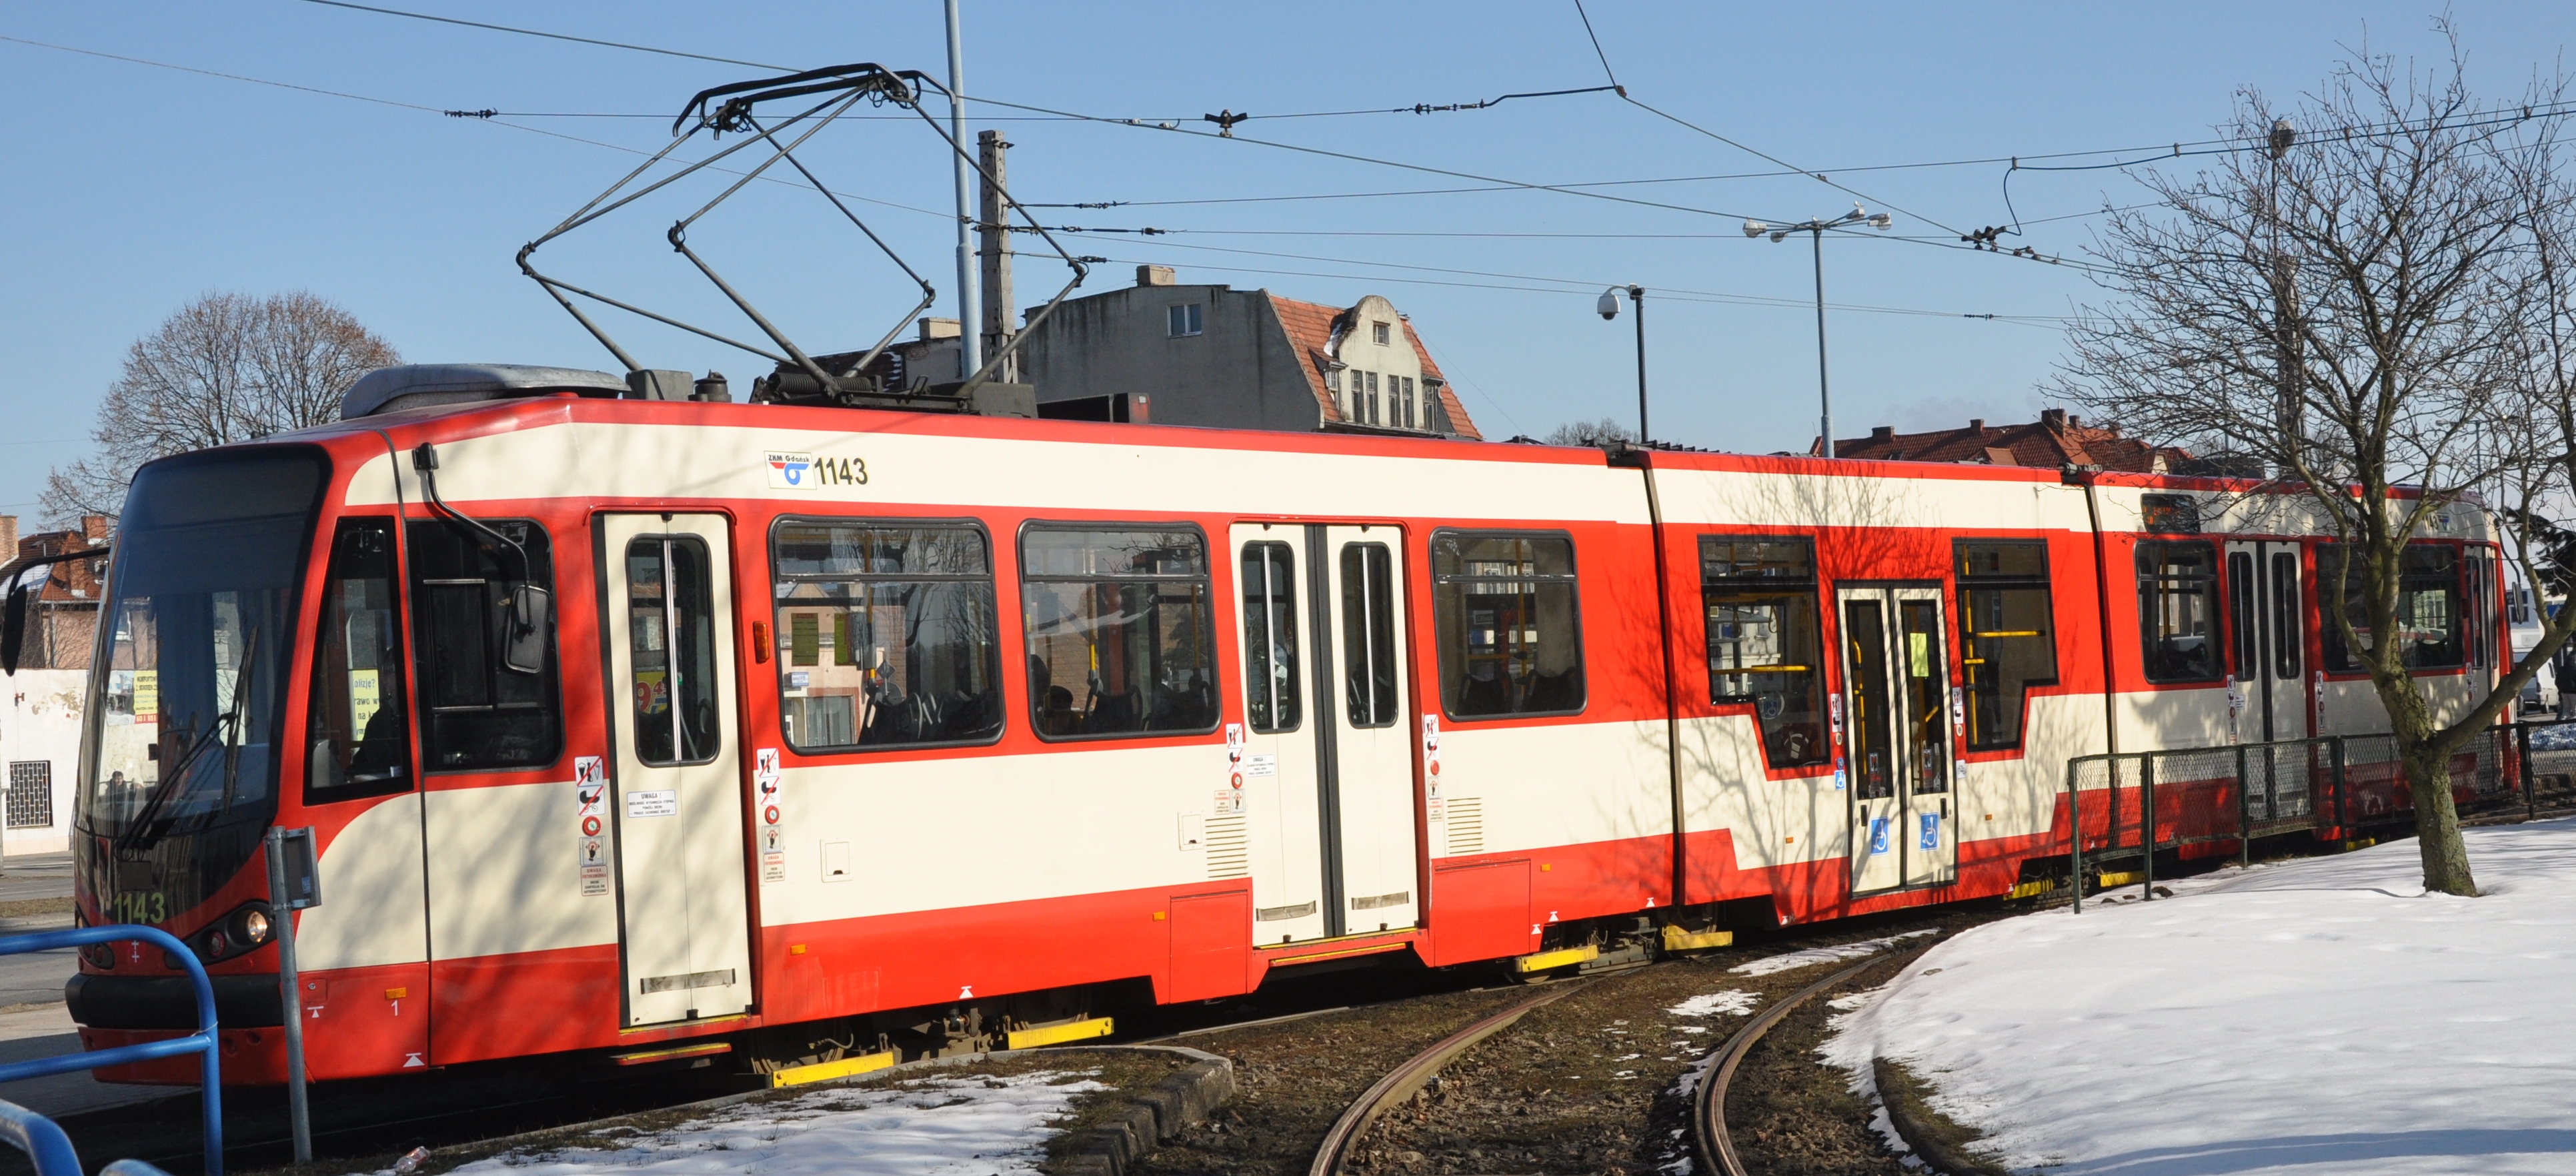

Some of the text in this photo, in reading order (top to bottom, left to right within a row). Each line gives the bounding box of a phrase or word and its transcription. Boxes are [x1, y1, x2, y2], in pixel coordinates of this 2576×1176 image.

[814, 458, 868, 485] 1143
[114, 892, 165, 925] 1143
[391, 1000, 398, 1017] 1
